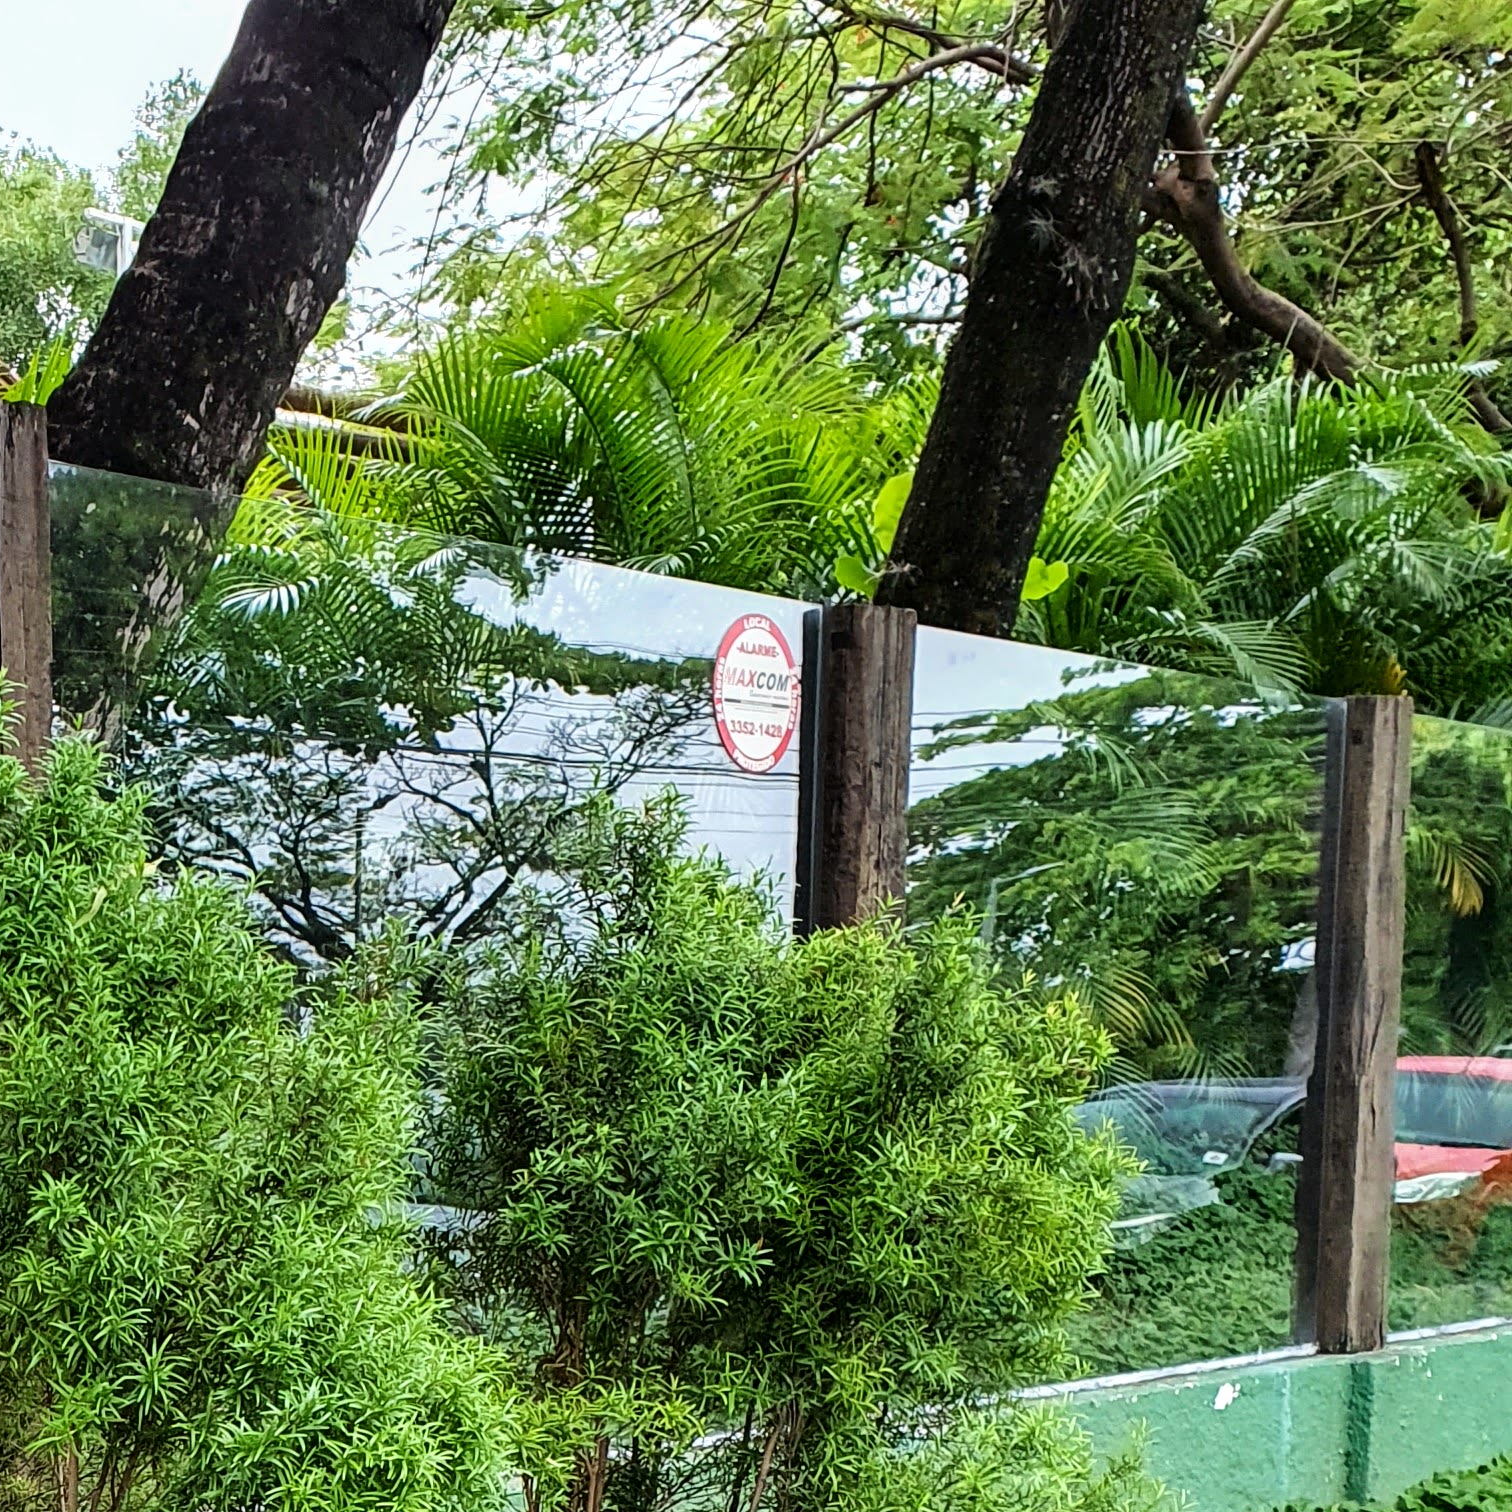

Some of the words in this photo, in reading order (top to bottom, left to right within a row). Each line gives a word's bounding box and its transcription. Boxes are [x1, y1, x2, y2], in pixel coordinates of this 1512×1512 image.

[743, 616, 772, 631] LOCAL
[724, 667, 788, 692] MAXCOM
[730, 719, 783, 738] 3352-1428
